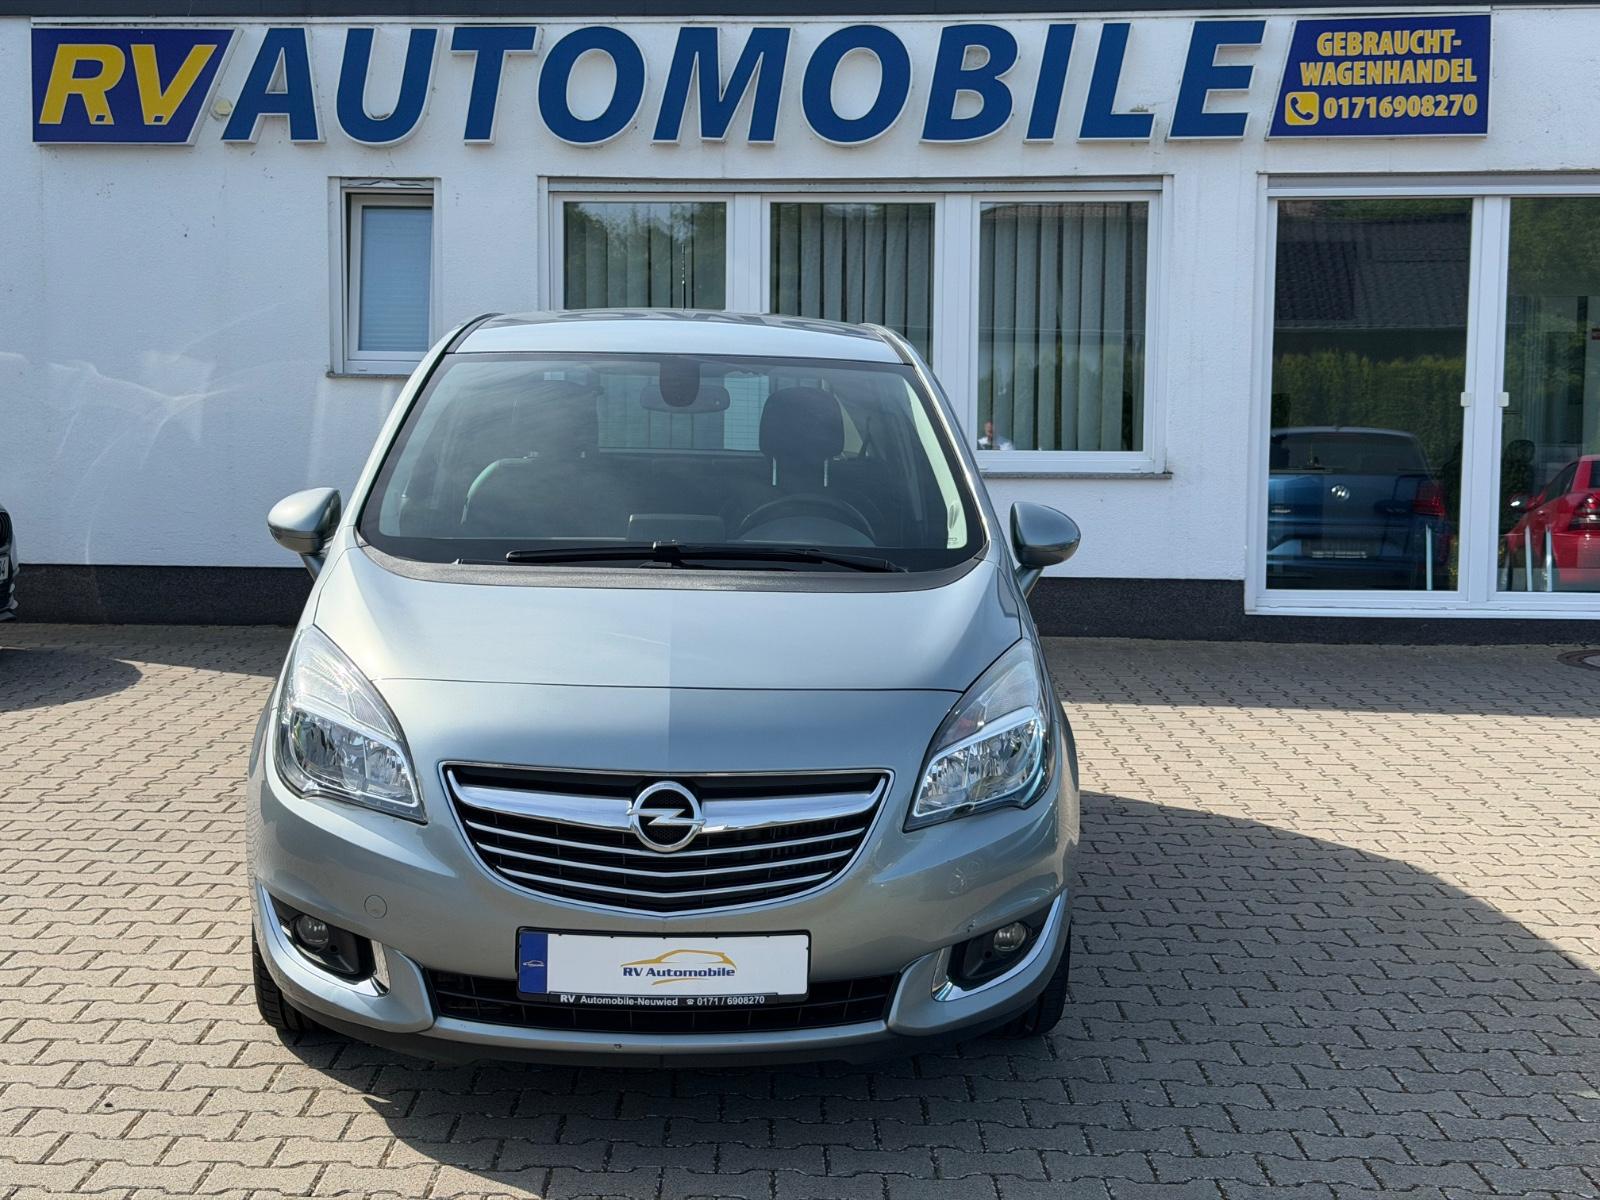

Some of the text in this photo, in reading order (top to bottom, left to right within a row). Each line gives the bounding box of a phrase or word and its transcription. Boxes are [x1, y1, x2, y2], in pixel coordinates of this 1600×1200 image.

[1316, 29, 1462, 57] GEBRAUCHT-
[39, 20, 1267, 146] RV AUTOMOBILE
[1299, 58, 1478, 87] WAGENHANDEL
[1323, 94, 1478, 120] 01716908270
[622, 967, 736, 978] RV Automobile
[559, 994, 576, 1004] RV
[580, 995, 679, 1007] Automobile-Neuwied
